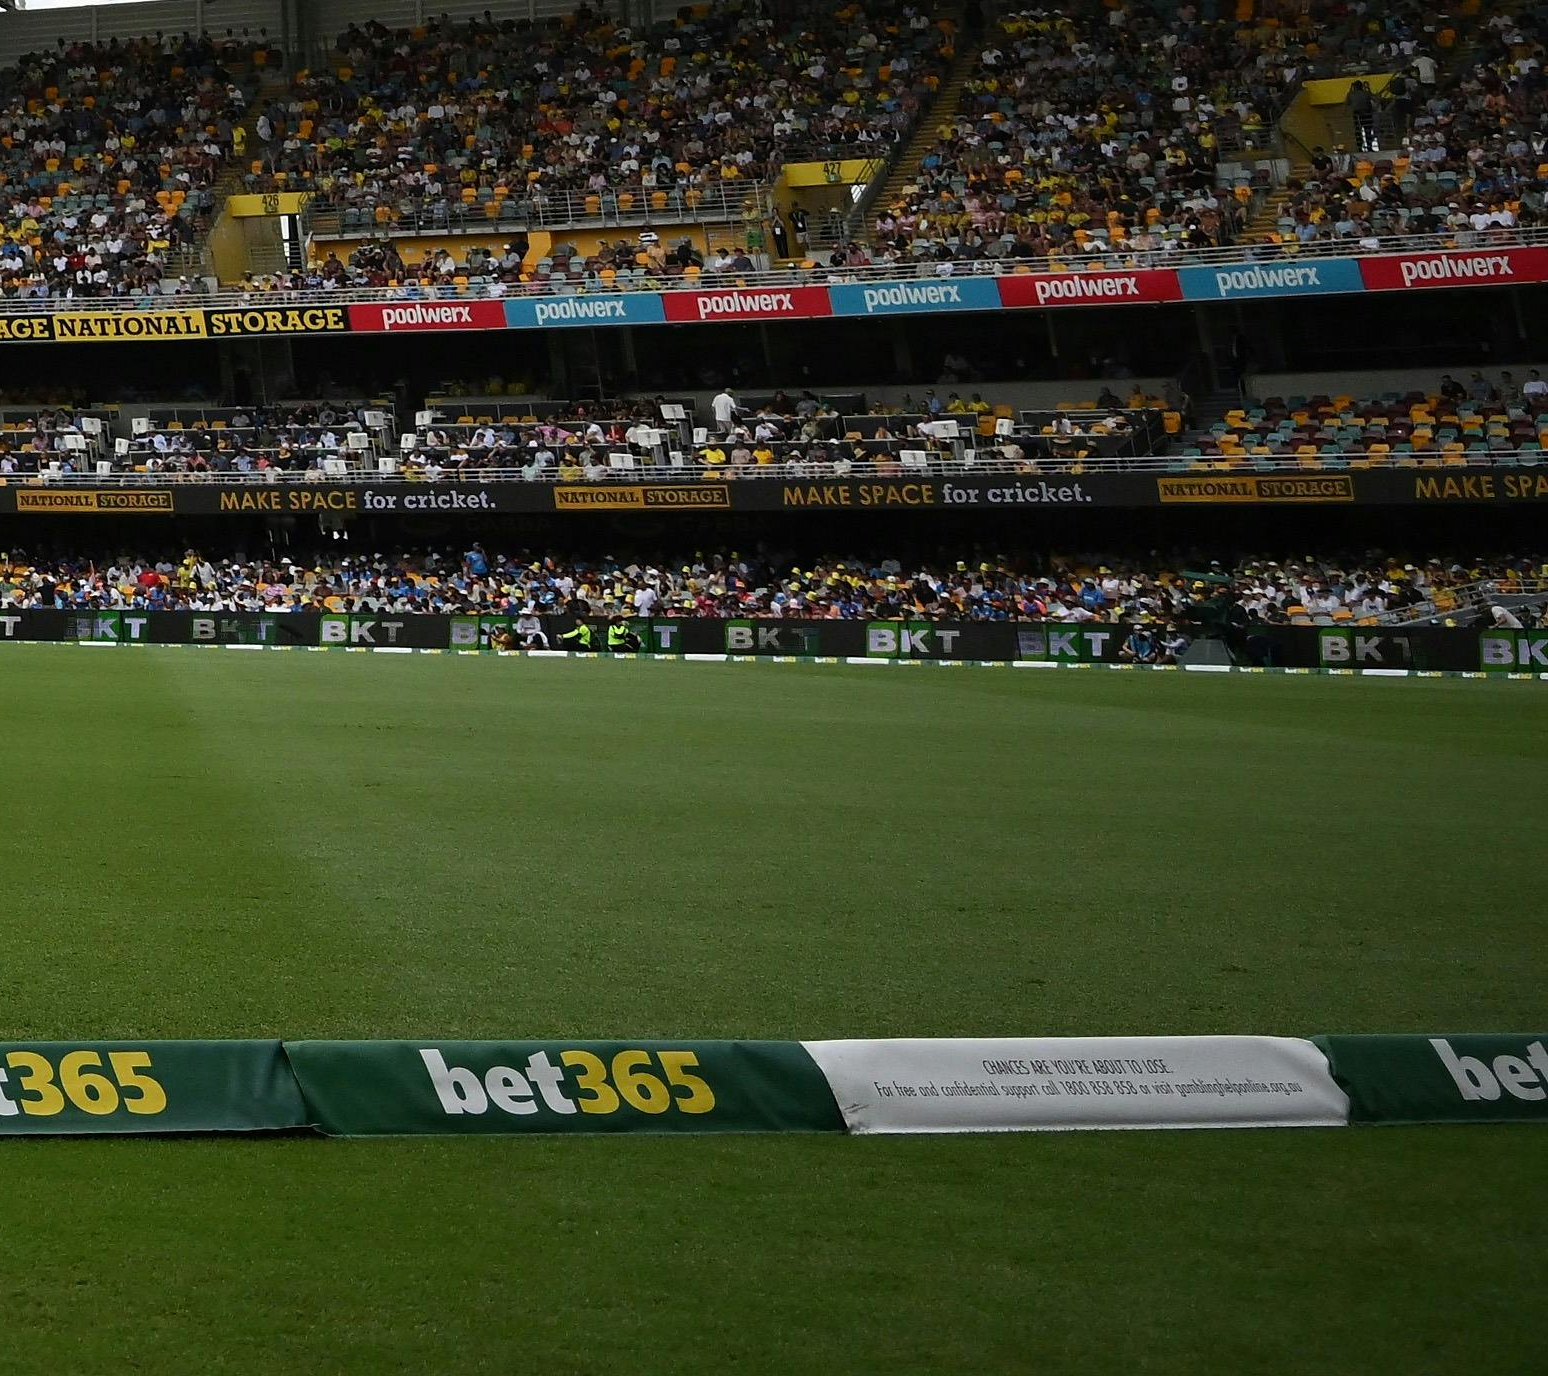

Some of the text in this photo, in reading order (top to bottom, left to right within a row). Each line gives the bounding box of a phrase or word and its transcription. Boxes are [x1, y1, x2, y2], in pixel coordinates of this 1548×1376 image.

[823, 162, 840, 175] 427
[261, 195, 279, 207] 426
[1217, 266, 1320, 296] poolwerx
[1401, 255, 1514, 287] poolwerx
[1035, 276, 1139, 304] poolwerx
[383, 303, 472, 328] poolwerx
[536, 299, 626, 324] poolwerx
[697, 293, 794, 318] poolwerx
[58, 310, 345, 337] NATIONAL STORAGE
[20, 495, 169, 507] NATIONAL STORAGE
[220, 490, 495, 510] MAKE SPACE for cricket.
[558, 489, 725, 505] NATIONAL STORAGE
[783, 482, 1092, 506] MAKE SPACE for cricket.
[322, 621, 403, 642] BKT
[869, 628, 960, 653] BKT
[983, 1060, 1030, 1074] CHANCES
[1031, 1060, 1053, 1074] ARE
[1093, 1060, 1127, 1074] ABOUT
[1126, 1060, 1142, 1074] TO
[419, 1049, 715, 1115] bet365
